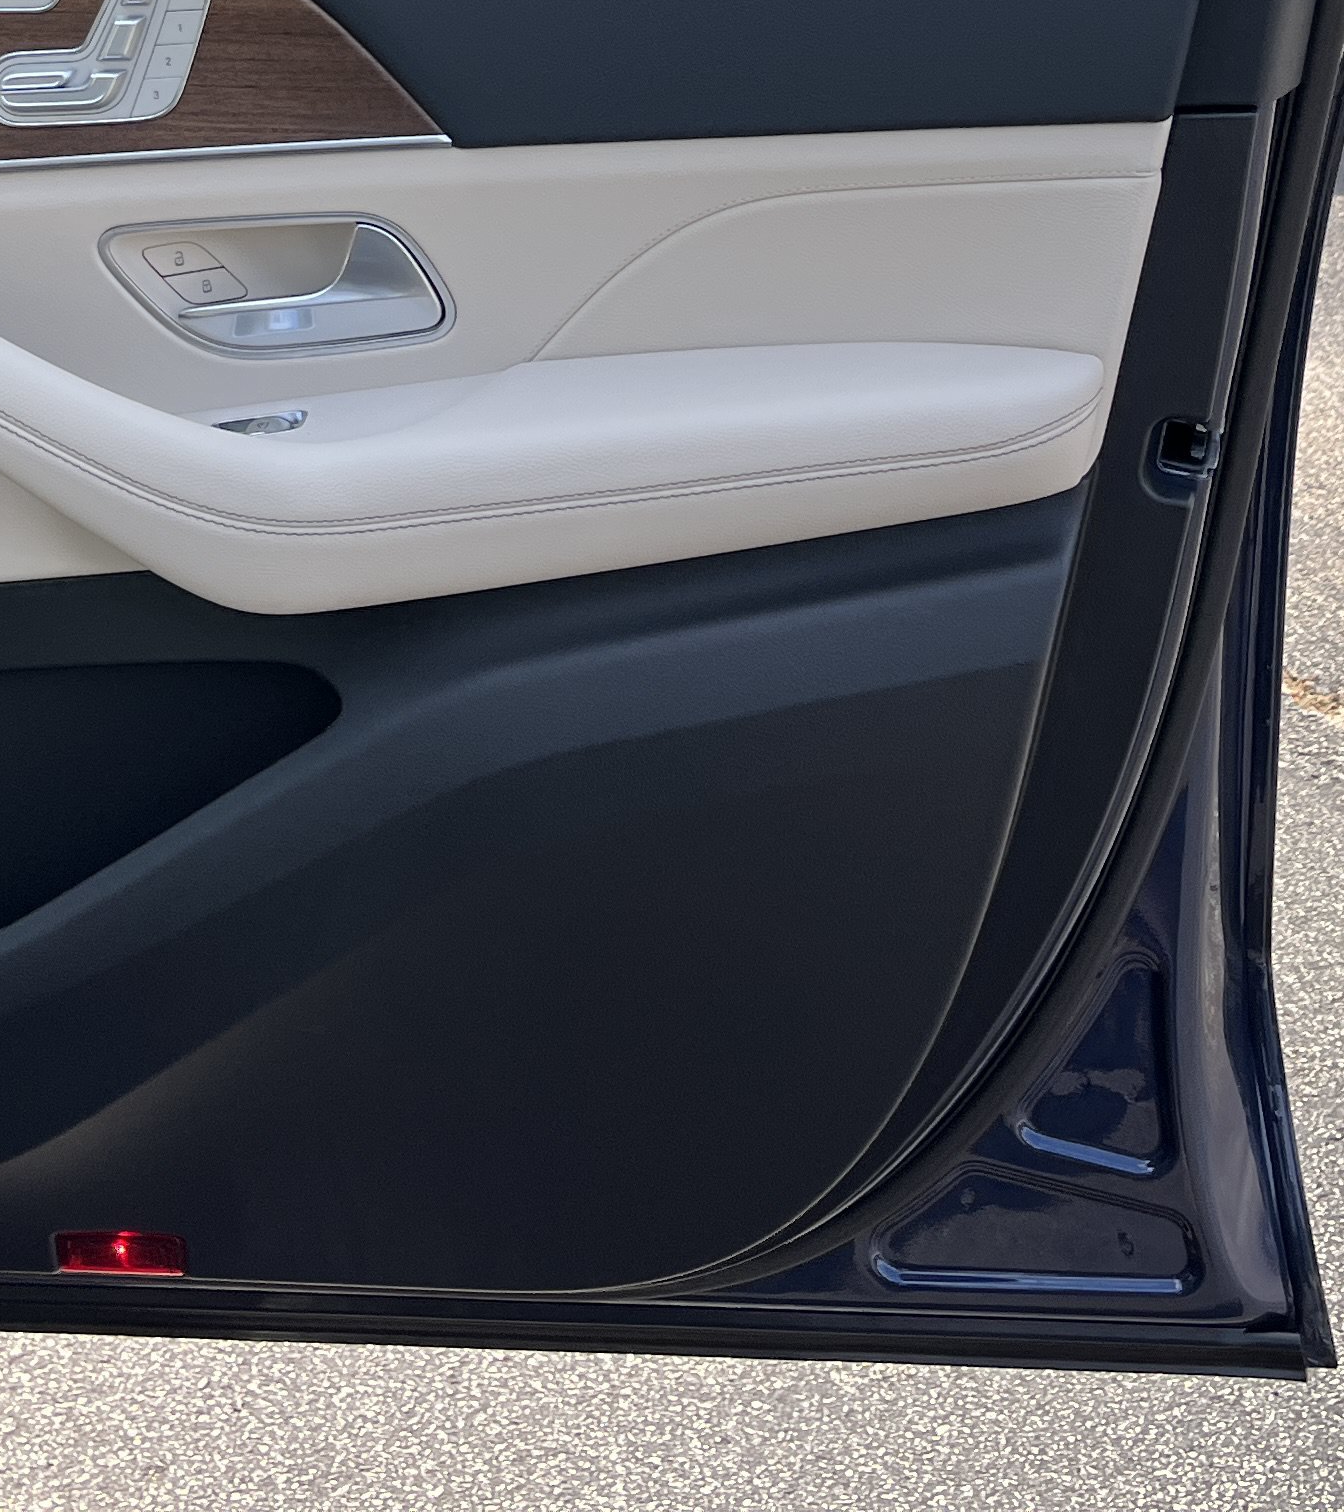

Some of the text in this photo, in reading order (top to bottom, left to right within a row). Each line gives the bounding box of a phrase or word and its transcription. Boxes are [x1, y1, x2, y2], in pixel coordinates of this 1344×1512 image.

[177, 23, 183, 32] 1
[165, 57, 172, 66] 2
[153, 90, 160, 100] 3
